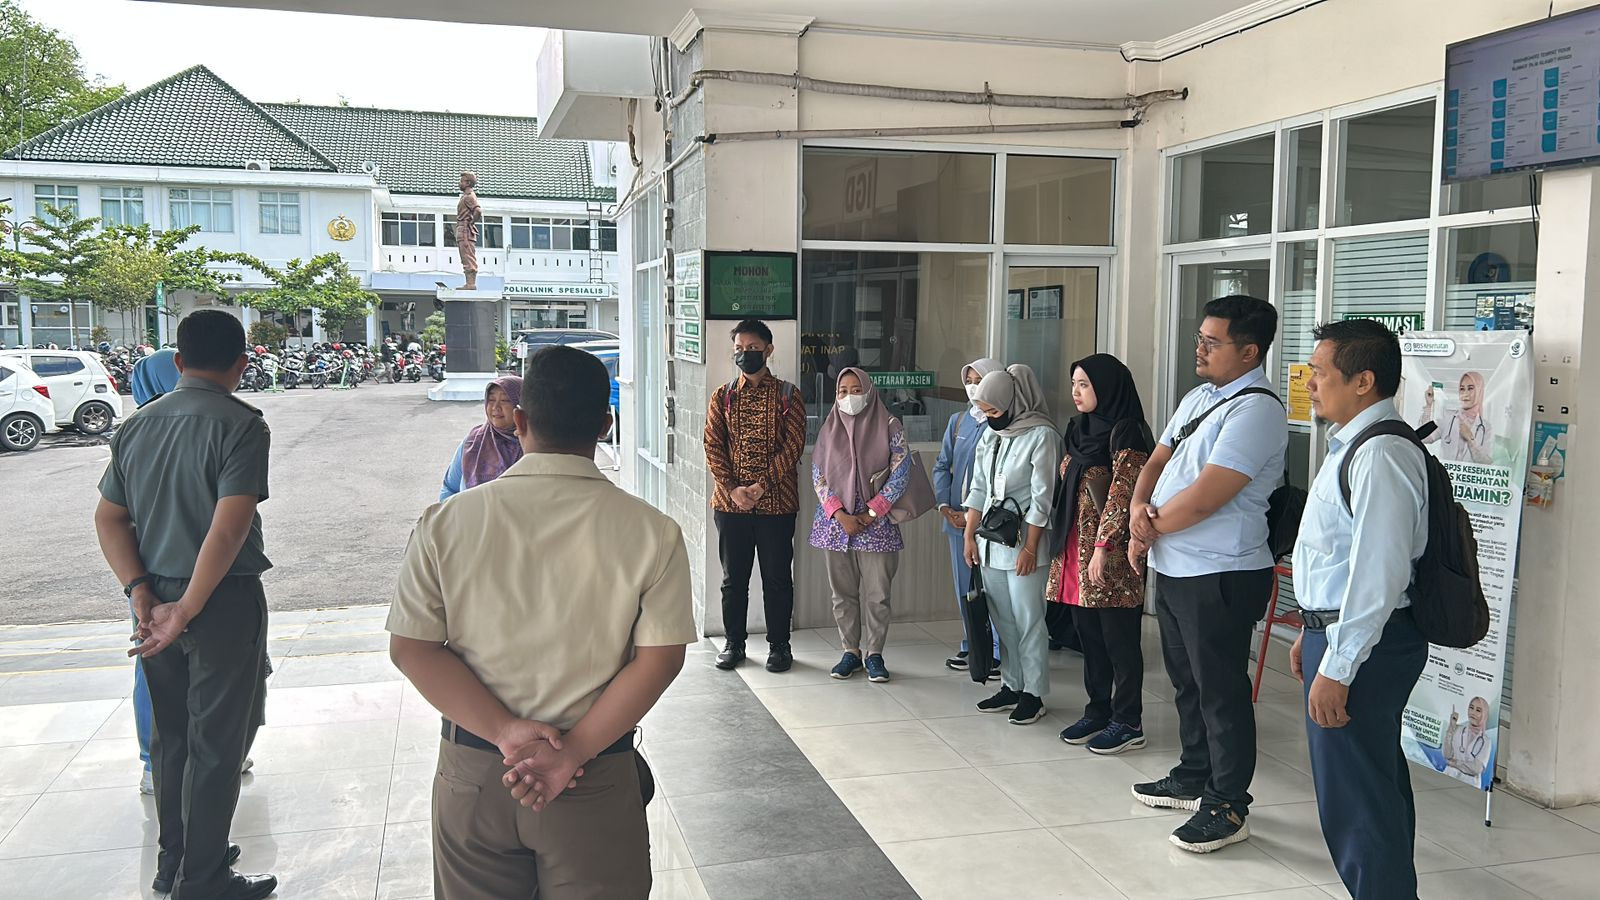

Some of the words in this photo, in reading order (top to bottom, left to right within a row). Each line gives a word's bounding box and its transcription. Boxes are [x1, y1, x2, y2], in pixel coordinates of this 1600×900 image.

[733, 266, 769, 276] MOHON
[820, 345, 846, 355] INAP
[906, 375, 931, 385] PASIEN
[1462, 465, 1510, 478] KESEHATAN
[1455, 473, 1509, 488] KESEHATAN
[1411, 710, 1425, 720] TIDAK
[1425, 716, 1442, 725] PERLU
